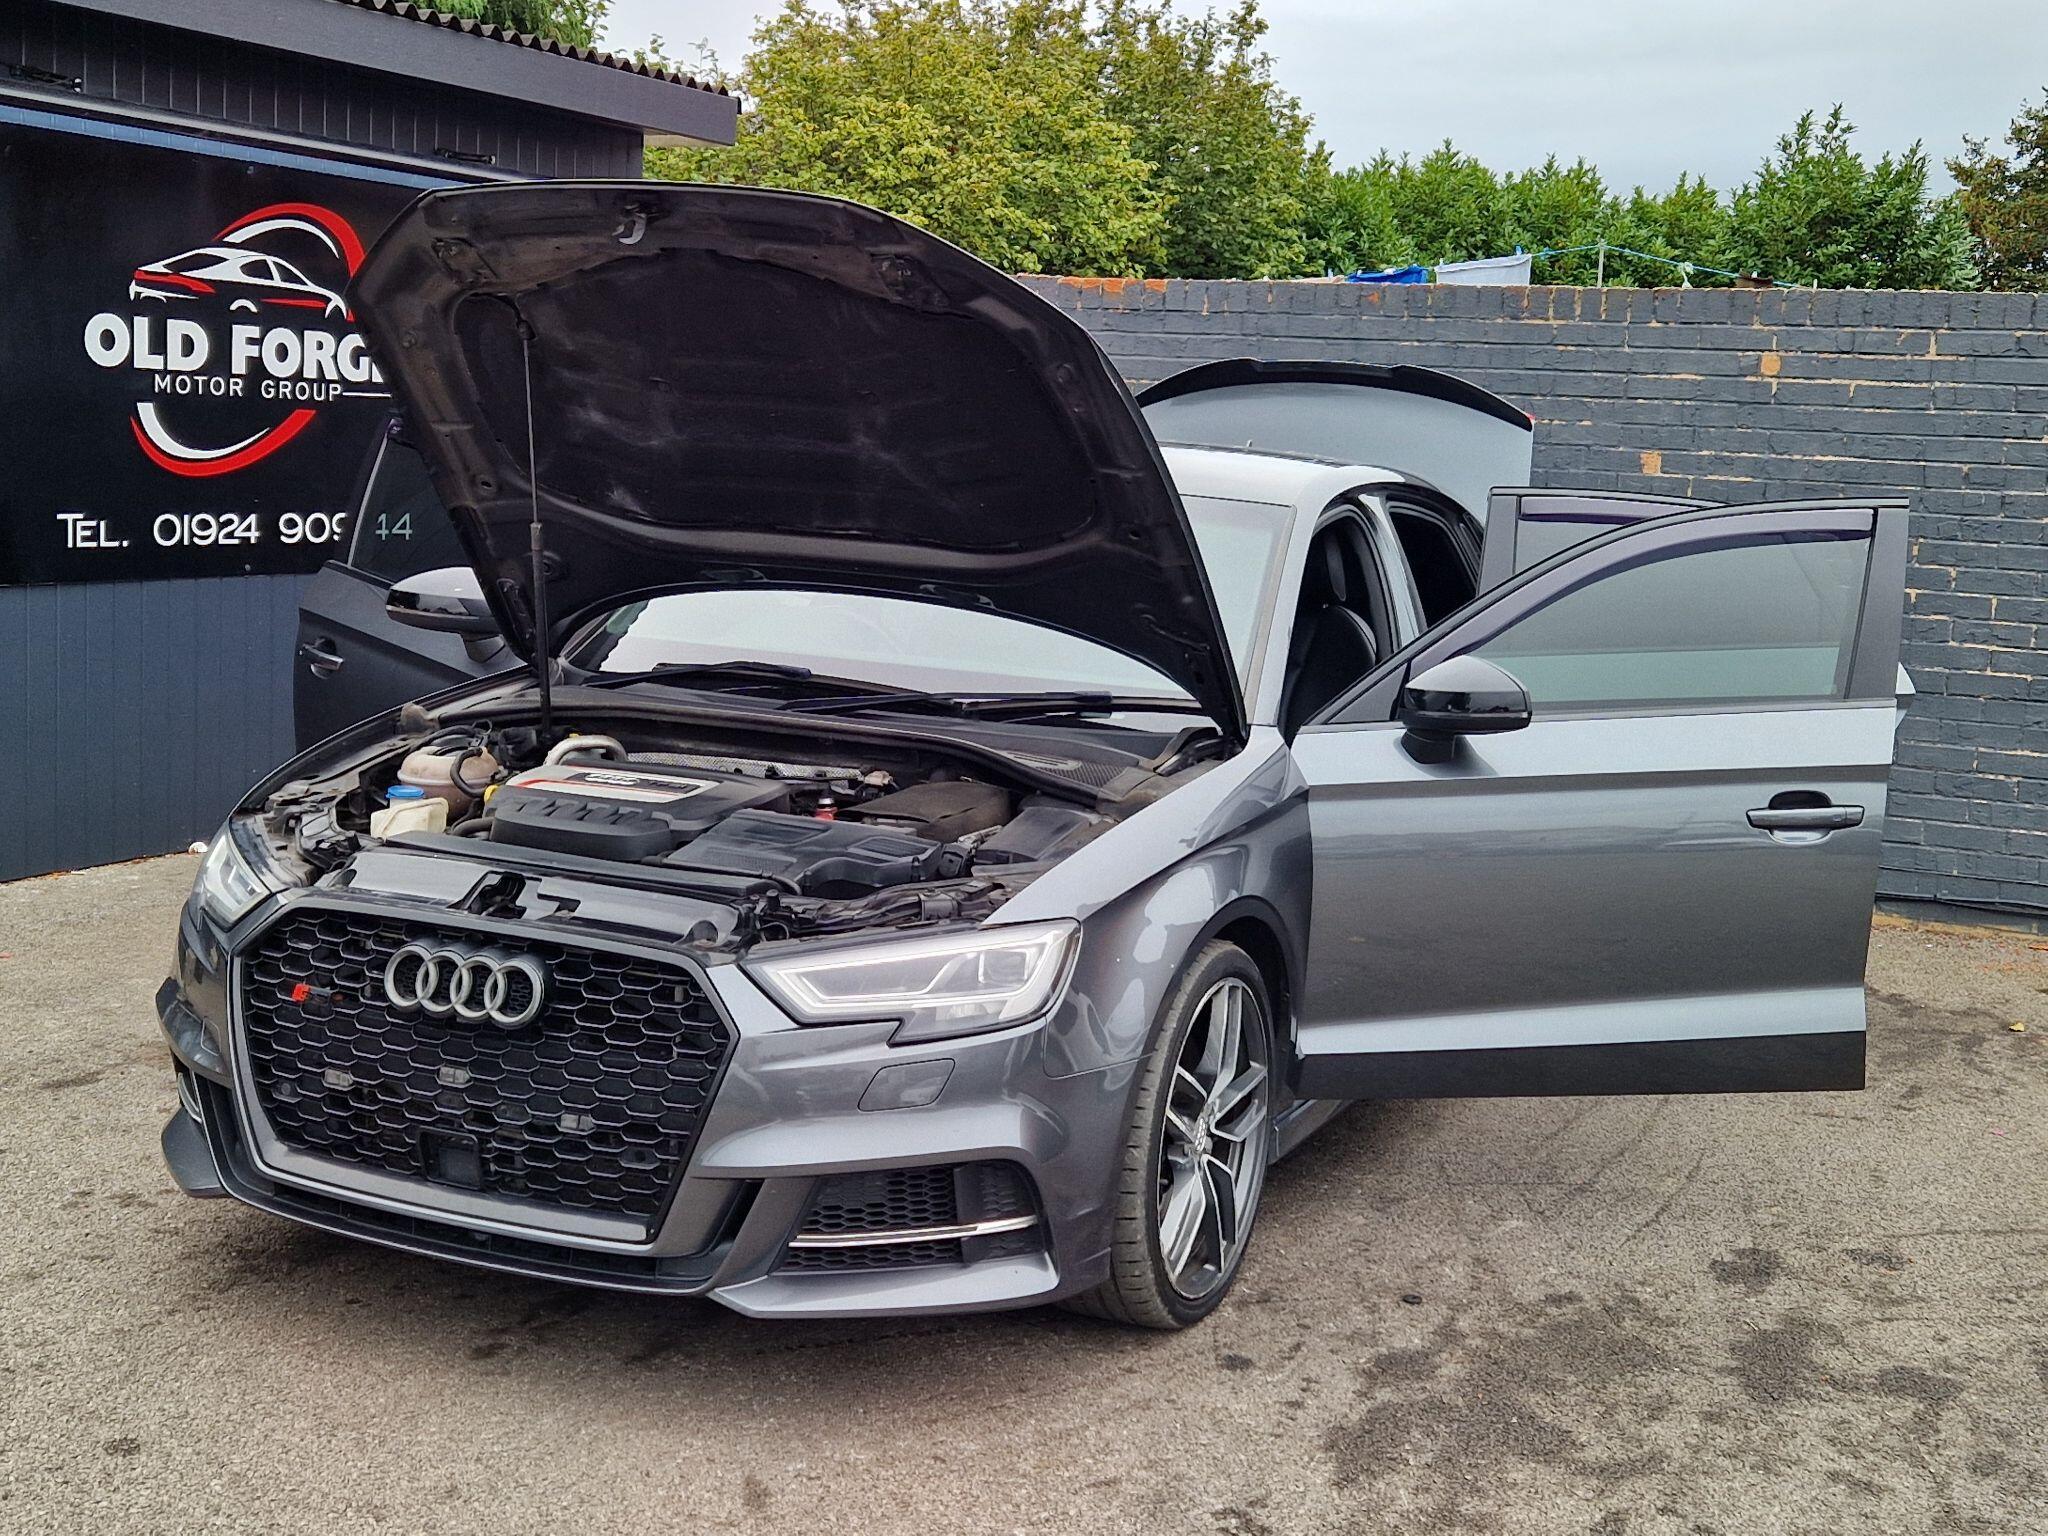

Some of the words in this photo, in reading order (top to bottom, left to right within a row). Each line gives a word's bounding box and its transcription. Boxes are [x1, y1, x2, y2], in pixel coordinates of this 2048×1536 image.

[84, 312, 209, 371] OLD
[231, 324, 384, 383] FORG
[154, 373, 243, 397] MOTOR
[261, 379, 342, 402] GROUP
[56, 513, 129, 548] TEL.
[153, 512, 260, 547] 01924
